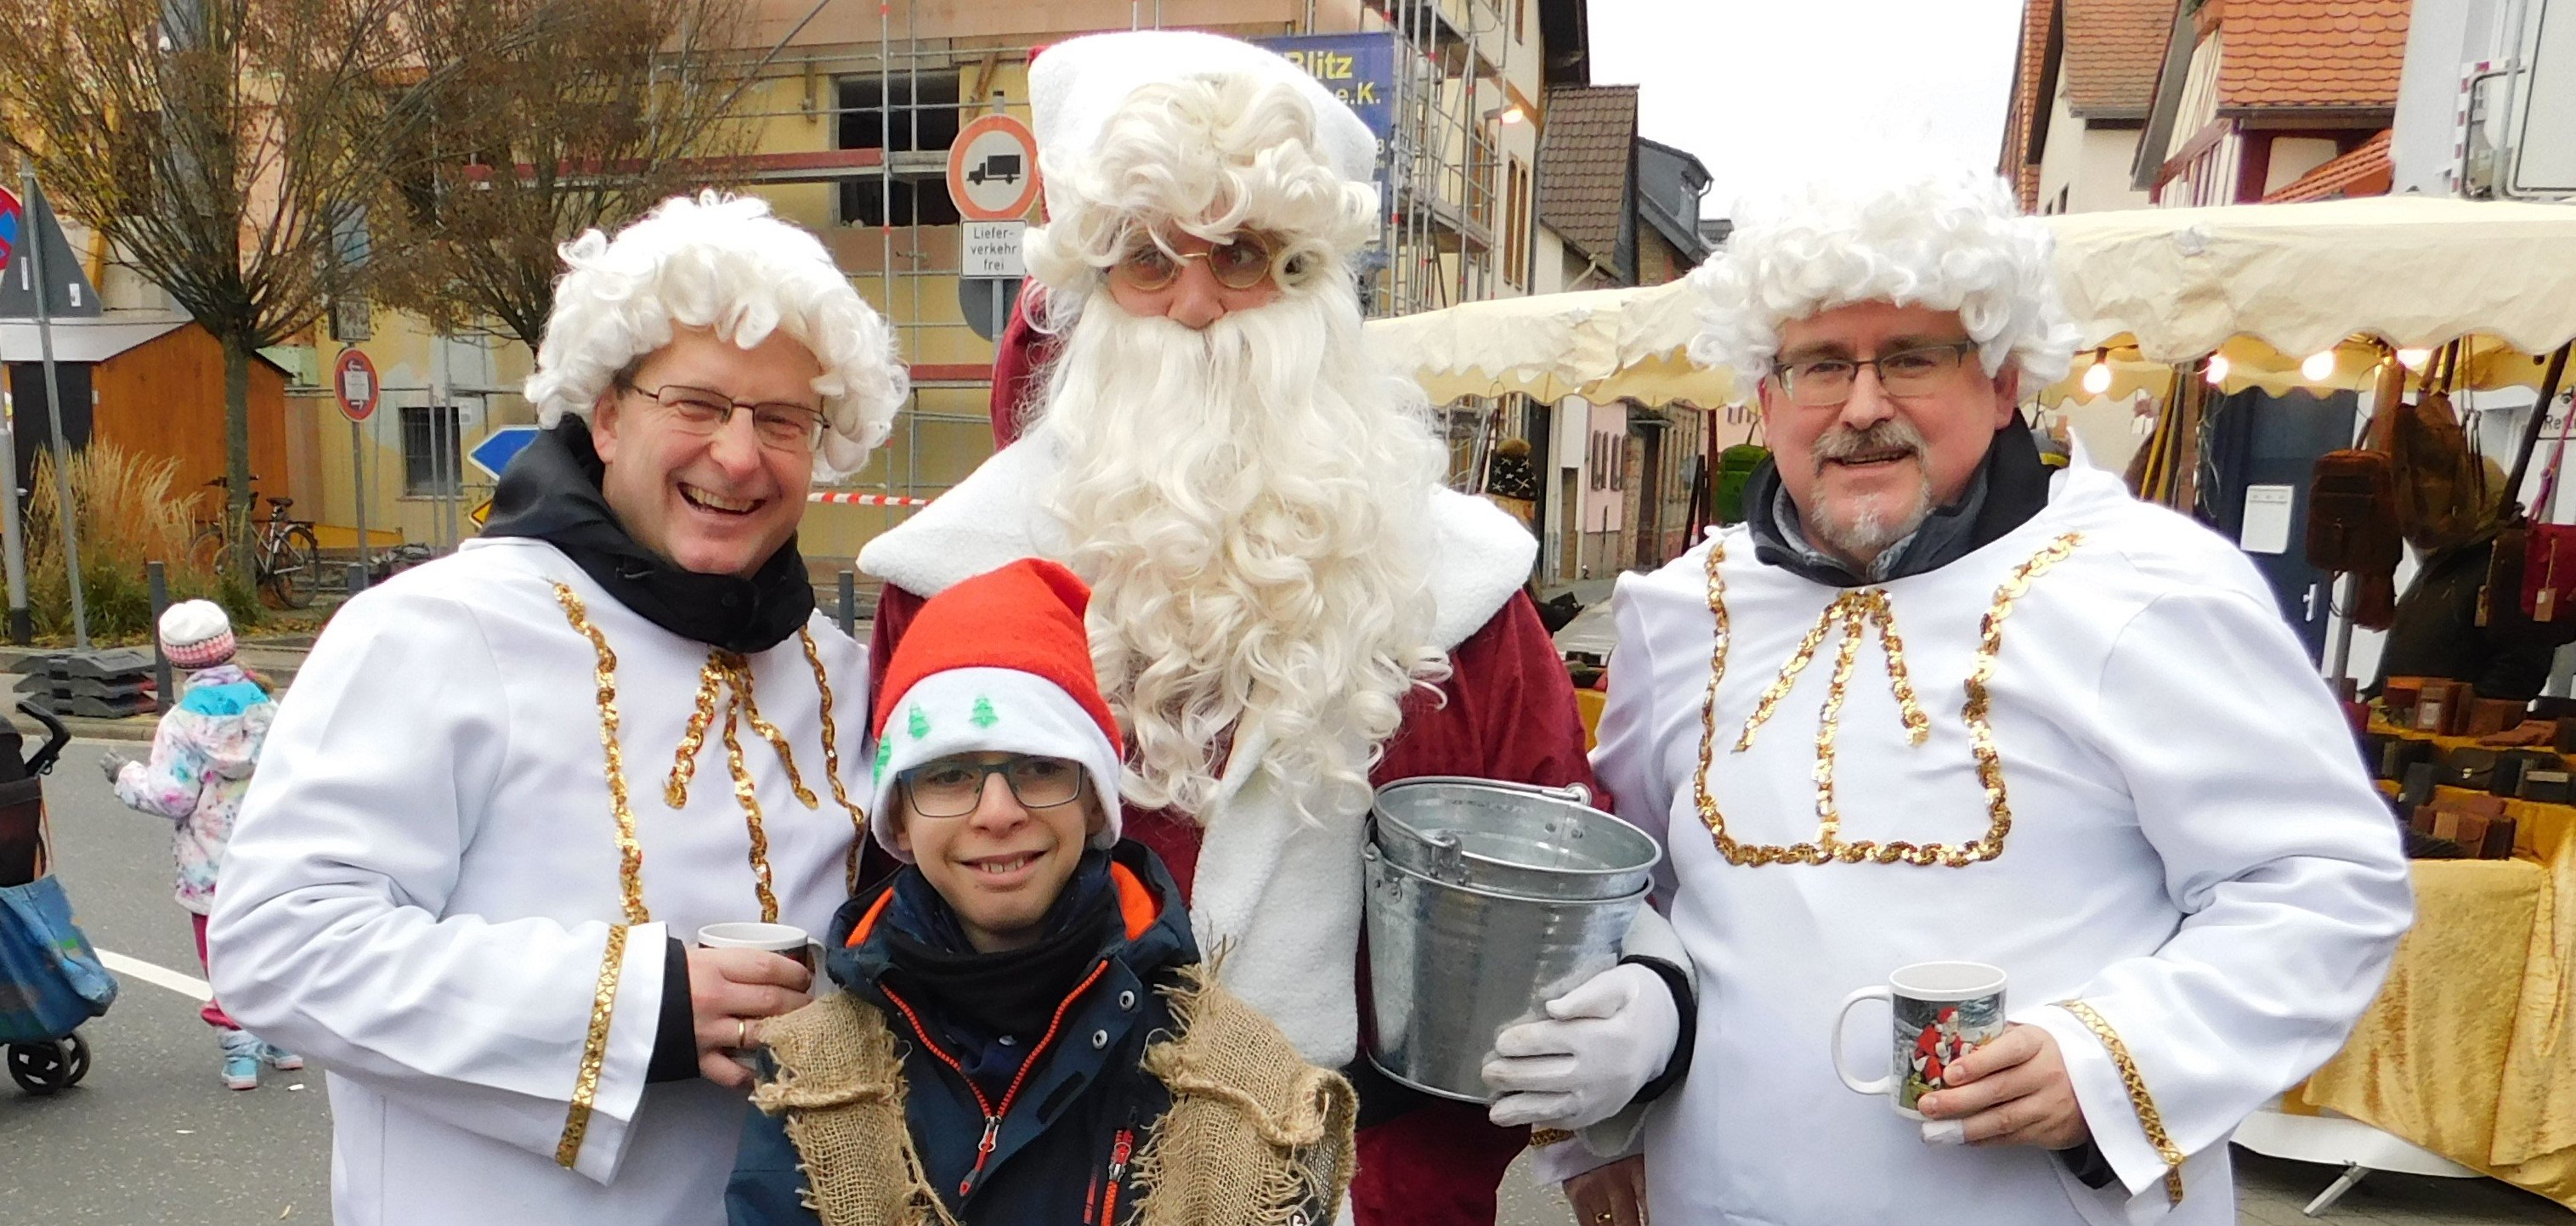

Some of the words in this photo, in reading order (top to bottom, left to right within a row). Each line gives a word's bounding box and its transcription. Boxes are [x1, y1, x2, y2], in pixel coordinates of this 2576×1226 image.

[973, 226, 1015, 240] Liefer-
[970, 242, 1017, 255] verkehr
[983, 257, 1005, 270] frei
